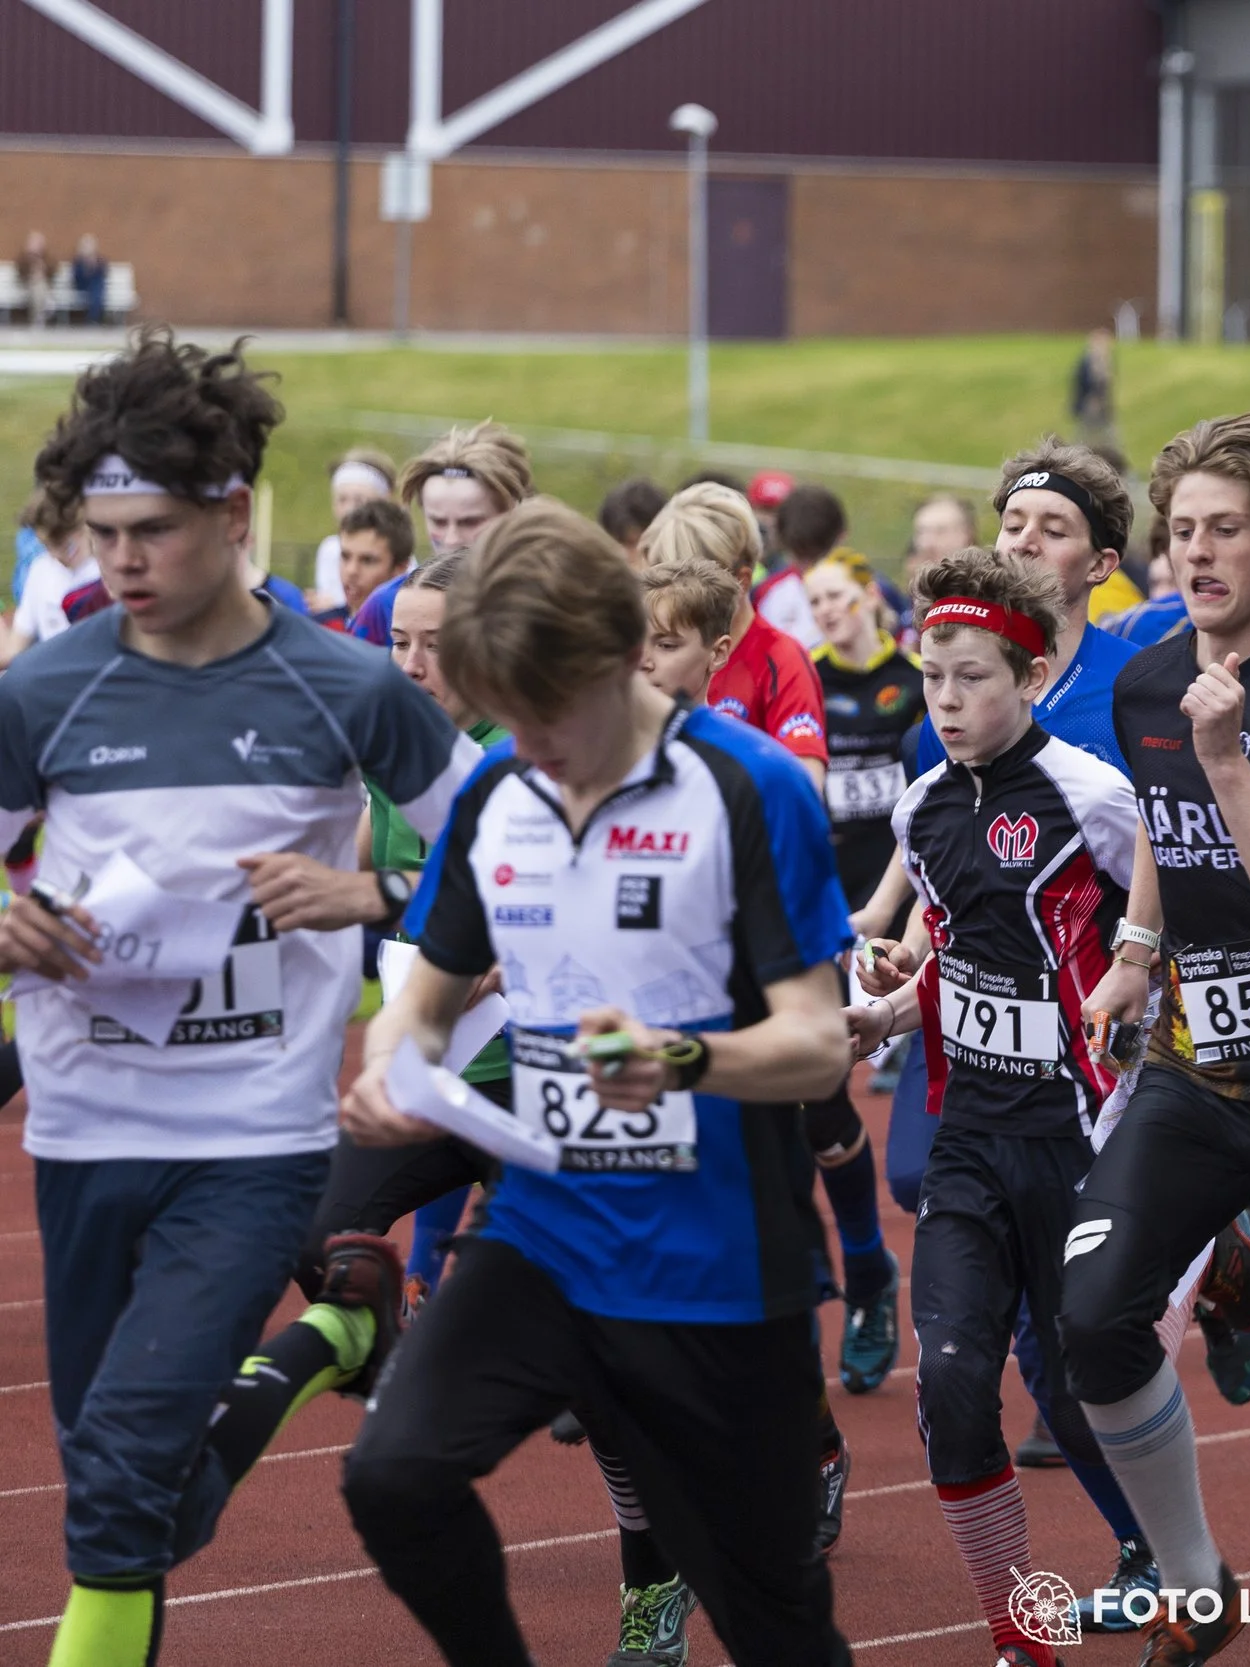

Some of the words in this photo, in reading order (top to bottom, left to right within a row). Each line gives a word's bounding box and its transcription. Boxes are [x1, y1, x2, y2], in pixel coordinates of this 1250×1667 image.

[1046, 663, 1083, 711] noname
[1000, 861, 1023, 869] MALVIK
[938, 950, 973, 974] Svenska
[1177, 948, 1224, 964] Svenska
[940, 964, 967, 984] kyrkan
[979, 971, 1015, 986] Finspångs
[1180, 963, 1219, 980] kyrkan
[979, 980, 1018, 997] församling
[1038, 973, 1050, 1000] 1
[174, 1019, 255, 1042] SPÅNG
[954, 991, 1022, 1053] 791
[957, 1047, 1035, 1076] FINSPÅNG
